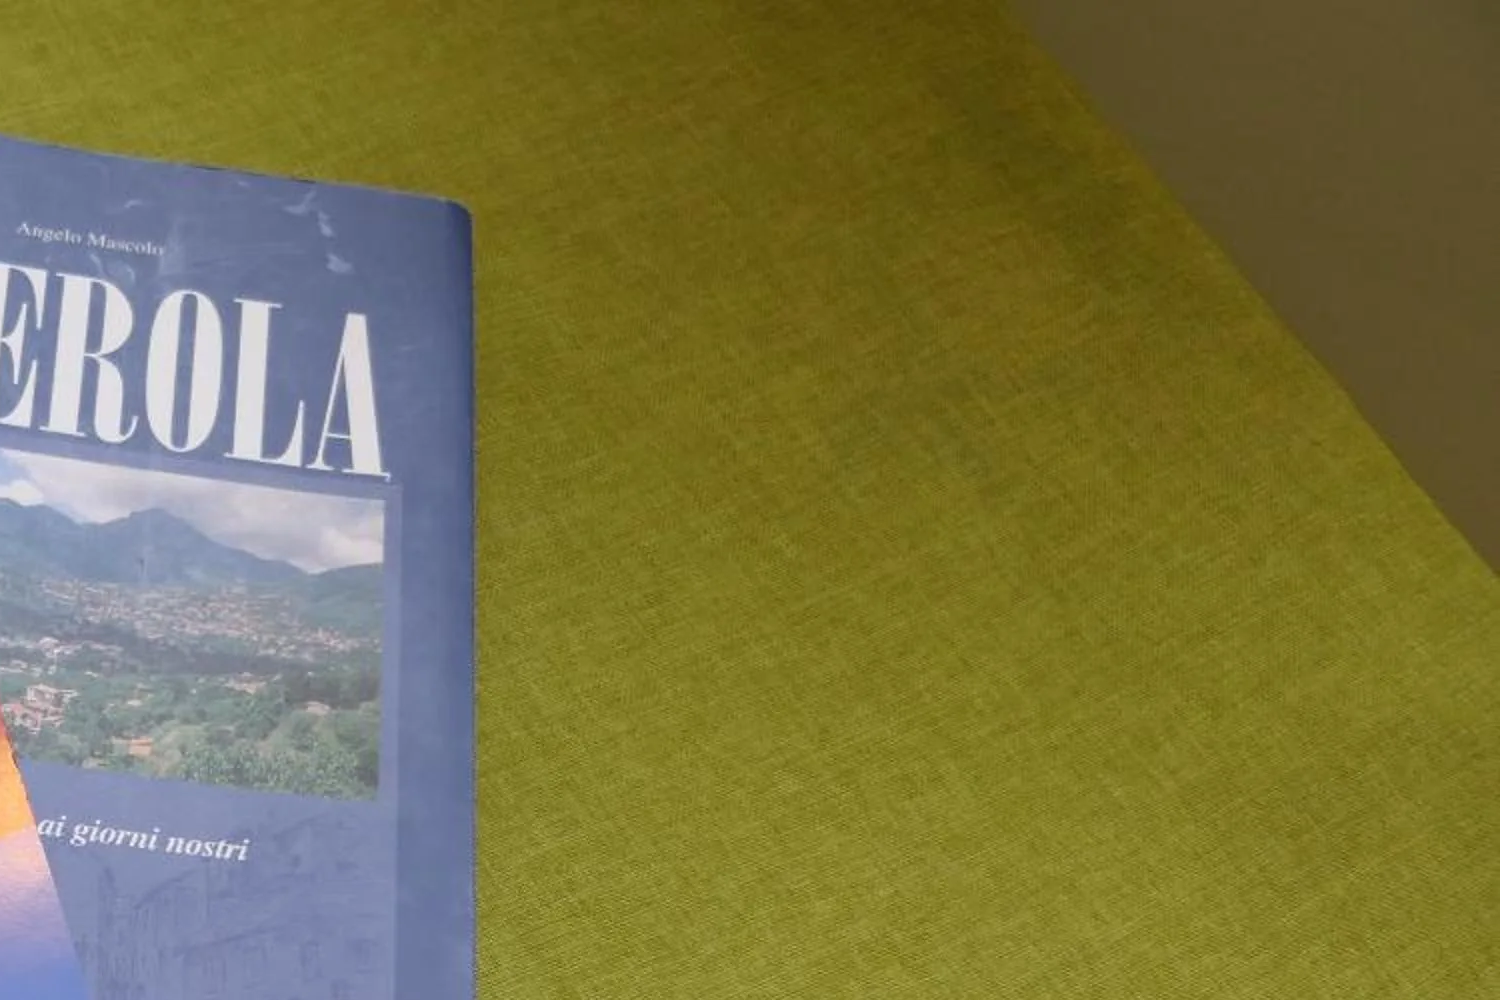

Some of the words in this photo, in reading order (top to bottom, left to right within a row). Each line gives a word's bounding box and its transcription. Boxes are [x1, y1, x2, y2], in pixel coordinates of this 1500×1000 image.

[16, 220, 82, 245] Angelo
[87, 230, 165, 256] Mascolo
[38, 815, 67, 837] ai
[69, 819, 161, 850] giorni
[164, 835, 250, 861] nostri
